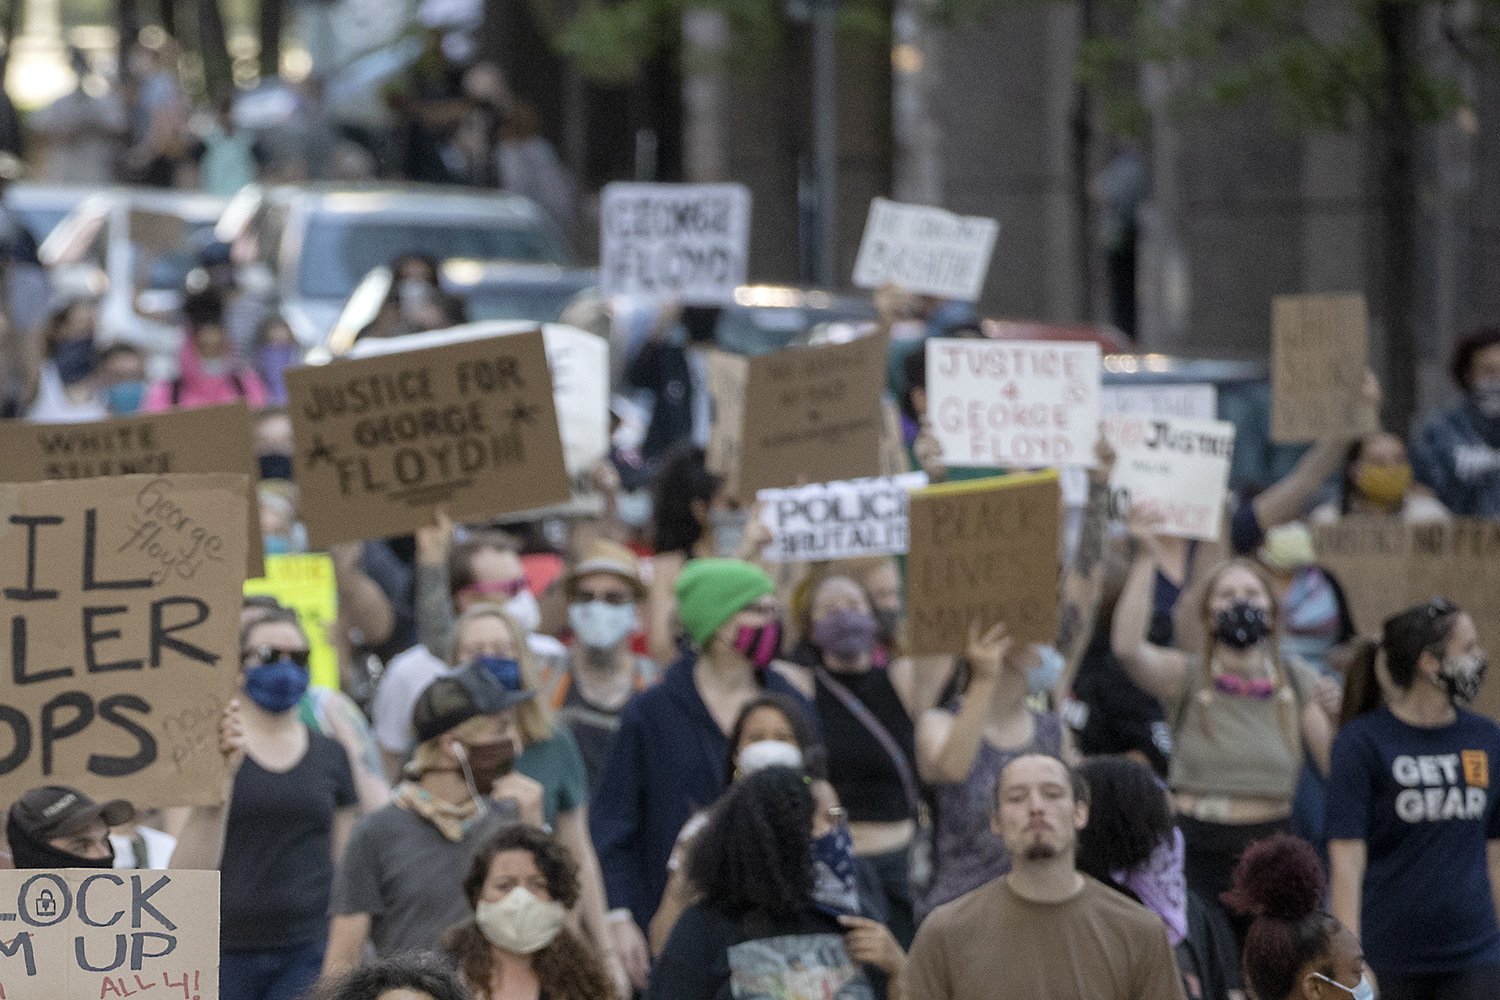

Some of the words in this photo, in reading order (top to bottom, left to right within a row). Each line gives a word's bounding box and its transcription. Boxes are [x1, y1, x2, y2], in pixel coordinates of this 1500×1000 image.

[938, 346, 1084, 379] JUSTICE
[303, 367, 434, 422] JUSTICE
[456, 355, 527, 396] FOR
[353, 400, 487, 448] GEORGE
[938, 396, 1072, 434] GEORGE
[969, 432, 1074, 464] FLOYD
[777, 490, 908, 524] POLIC
[1392, 752, 1460, 787] GET
[1395, 786, 1488, 823] GEAR
[74, 931, 179, 973] UP
[100, 973, 157, 1000] ALL
